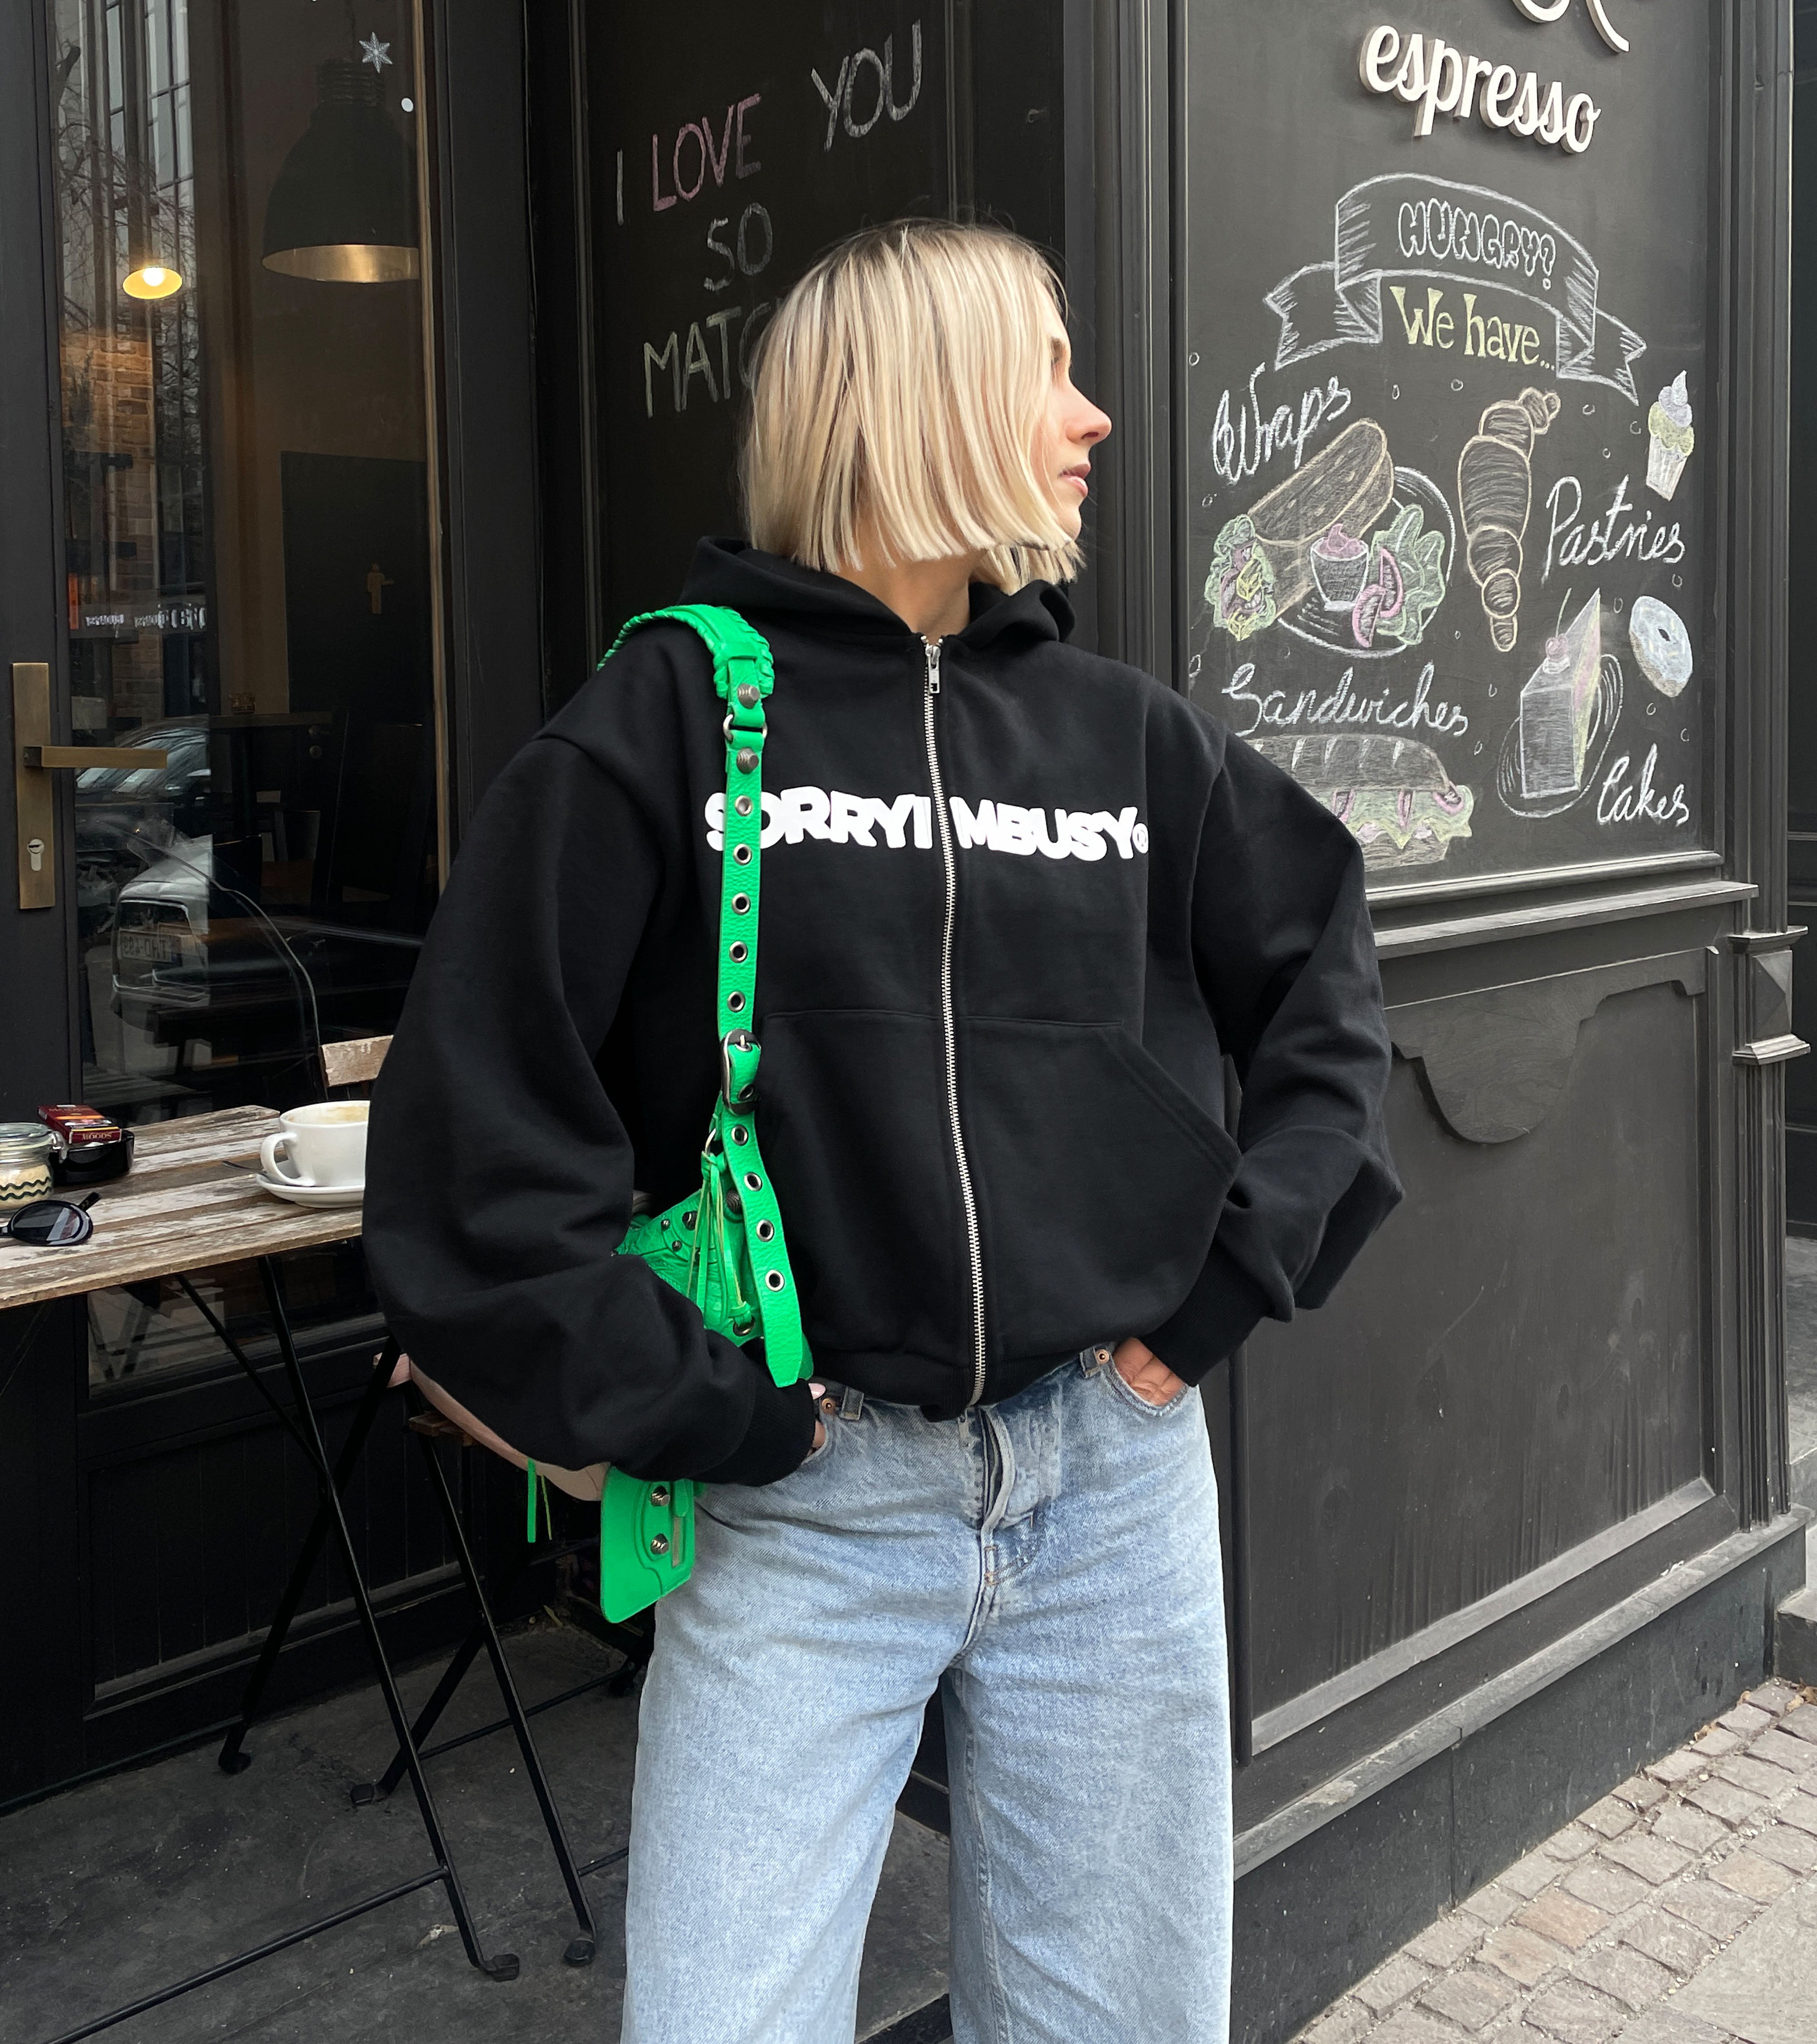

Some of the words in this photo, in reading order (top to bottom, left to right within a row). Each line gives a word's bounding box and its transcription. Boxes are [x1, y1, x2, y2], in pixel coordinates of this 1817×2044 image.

[617, 149, 623, 225] I
[652, 93, 762, 212] LOVE
[811, 19, 923, 152] YOU
[1359, 25, 1602, 154] espresso
[704, 203, 773, 291] SO
[1398, 198, 1556, 290] HUNGRY?
[644, 299, 780, 419] MATC
[1390, 286, 1454, 348] We
[1212, 362, 1351, 481] Wraps
[1541, 475, 1686, 584] Pastries
[1222, 663, 1469, 736] Sandwiches
[1596, 744, 1689, 826] Cakes
